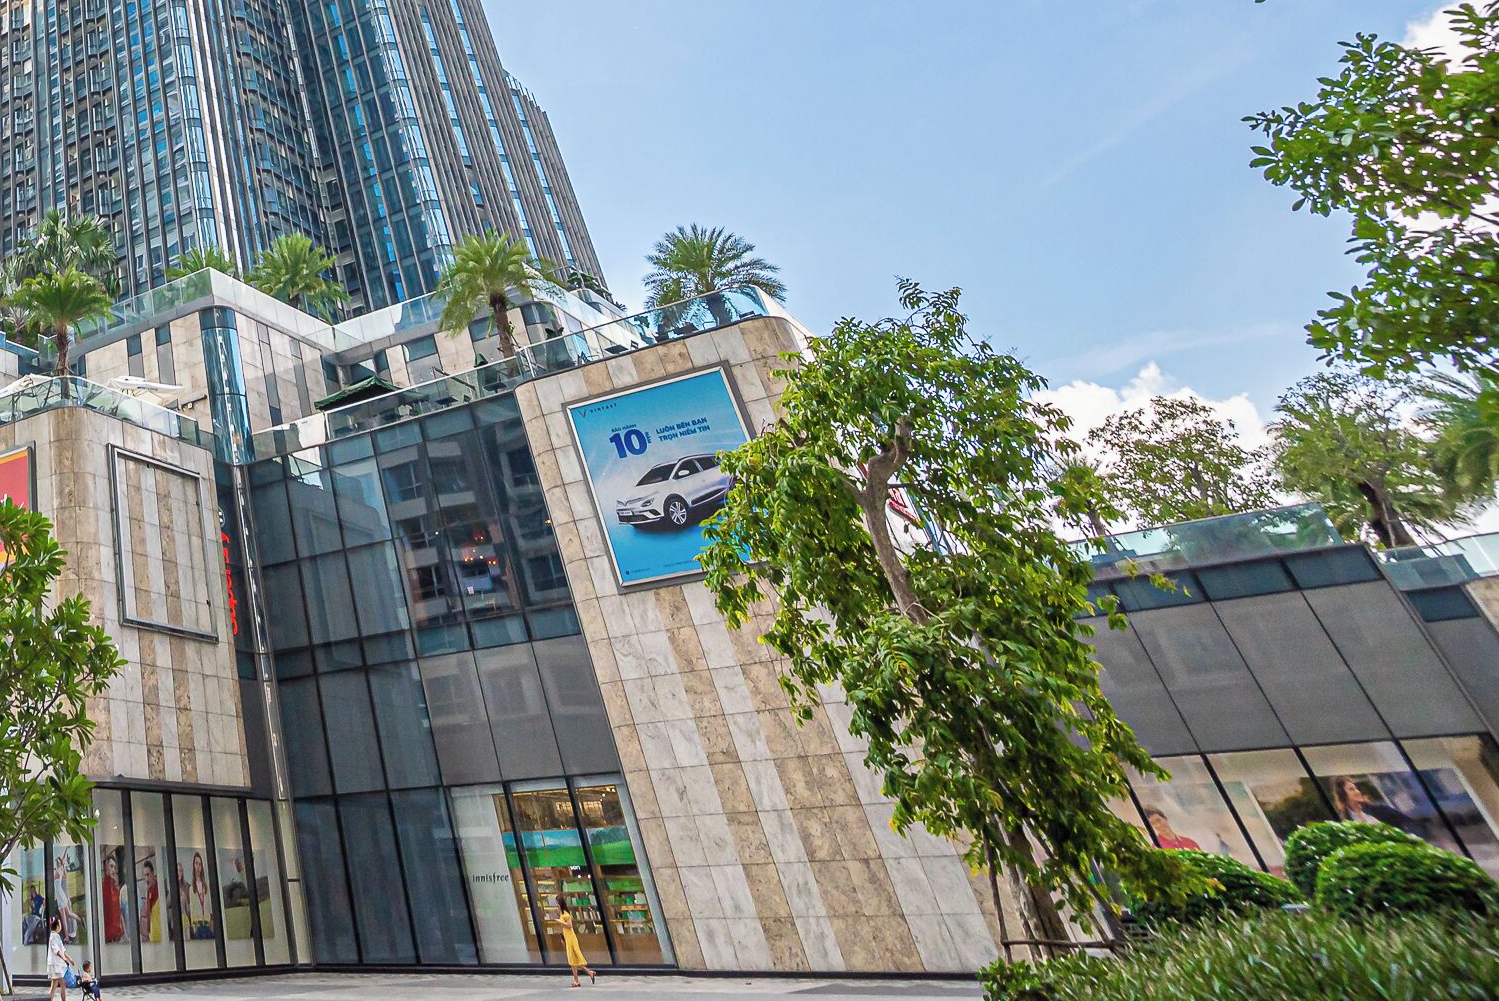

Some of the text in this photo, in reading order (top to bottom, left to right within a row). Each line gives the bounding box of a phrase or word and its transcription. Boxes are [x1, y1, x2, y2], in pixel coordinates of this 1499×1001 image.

[590, 403, 616, 413] VINFAST
[676, 421, 691, 430] BÊN
[698, 425, 711, 433] TIN
[609, 428, 648, 459] 10
[472, 872, 510, 884] innisfree
